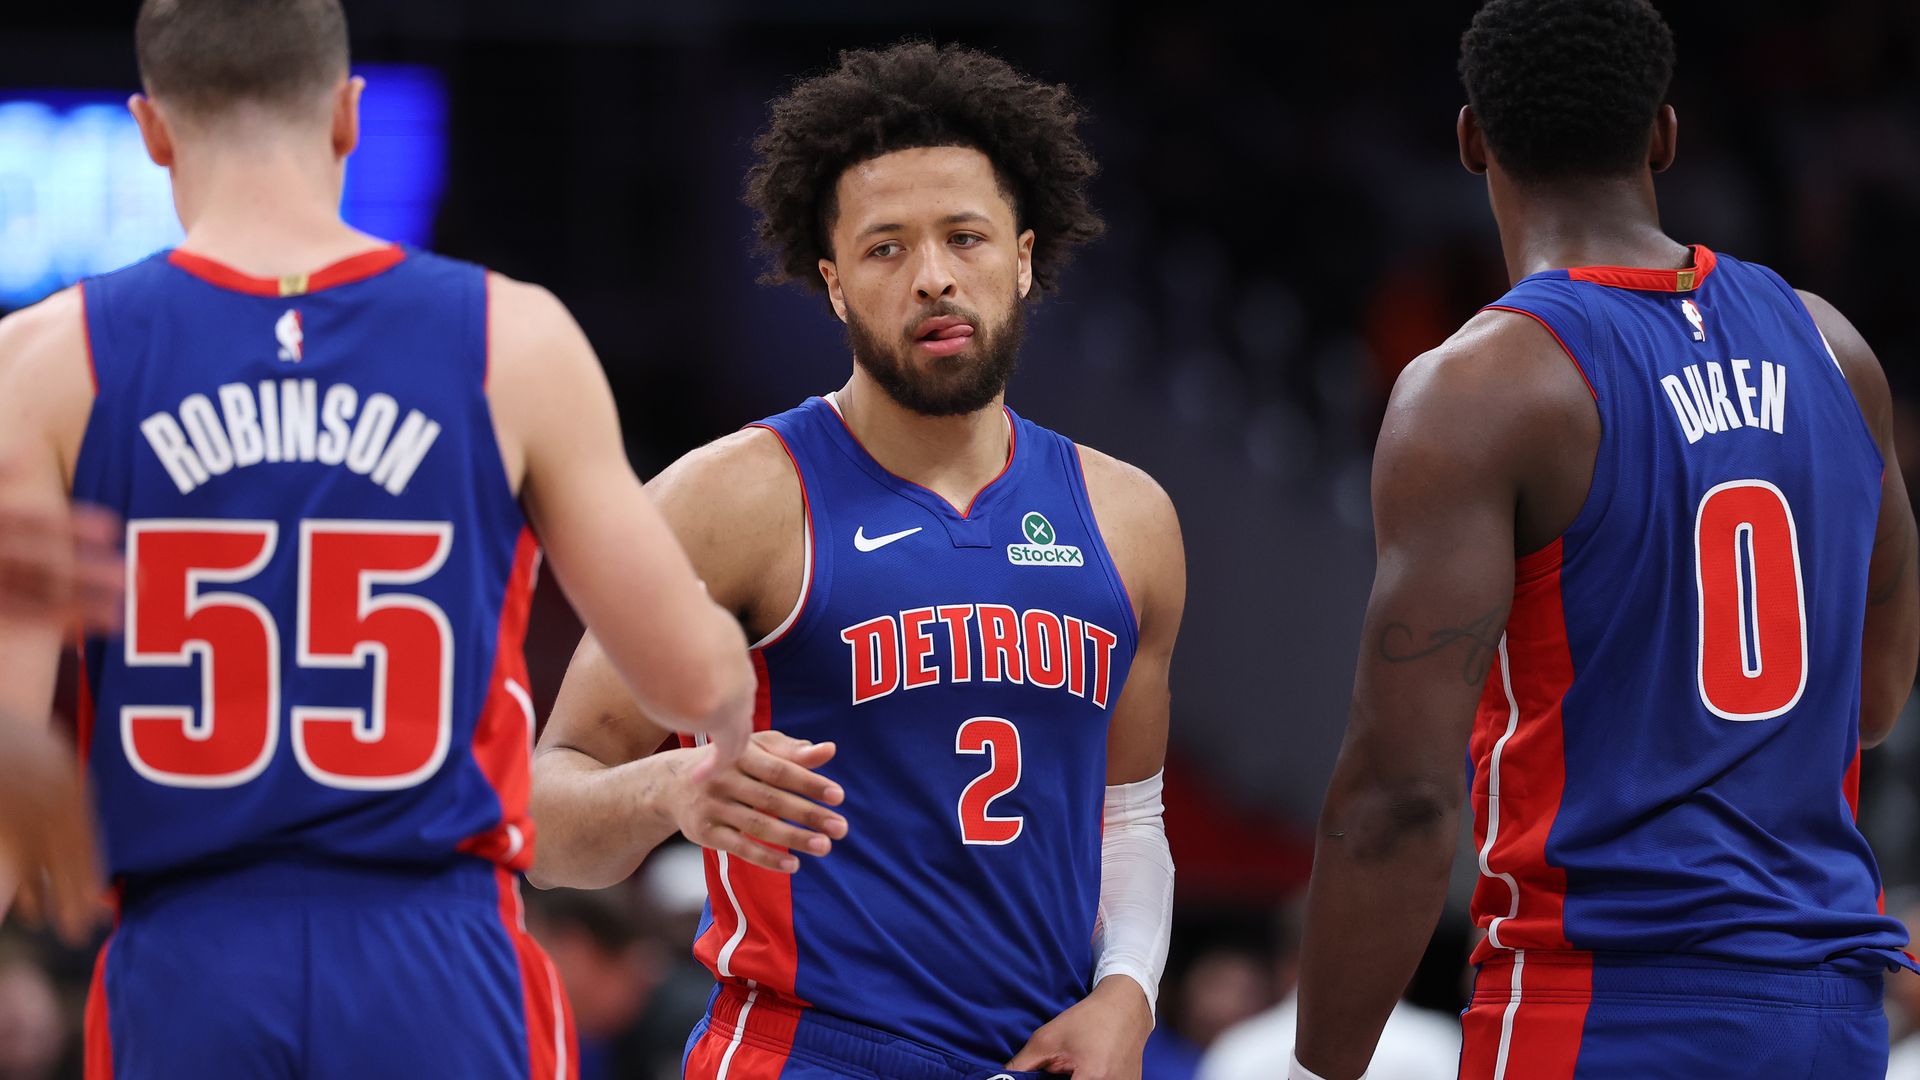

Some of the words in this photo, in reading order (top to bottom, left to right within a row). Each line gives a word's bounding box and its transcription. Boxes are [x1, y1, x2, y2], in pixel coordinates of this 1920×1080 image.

[139, 378, 442, 497] ROBINSON
[1660, 359, 1786, 445] DUREN
[1010, 546, 1082, 564] StockX
[1694, 479, 1809, 722] 0
[120, 518, 455, 791] 55
[840, 603, 1118, 710] DETROIT
[955, 716, 1024, 845] 2
